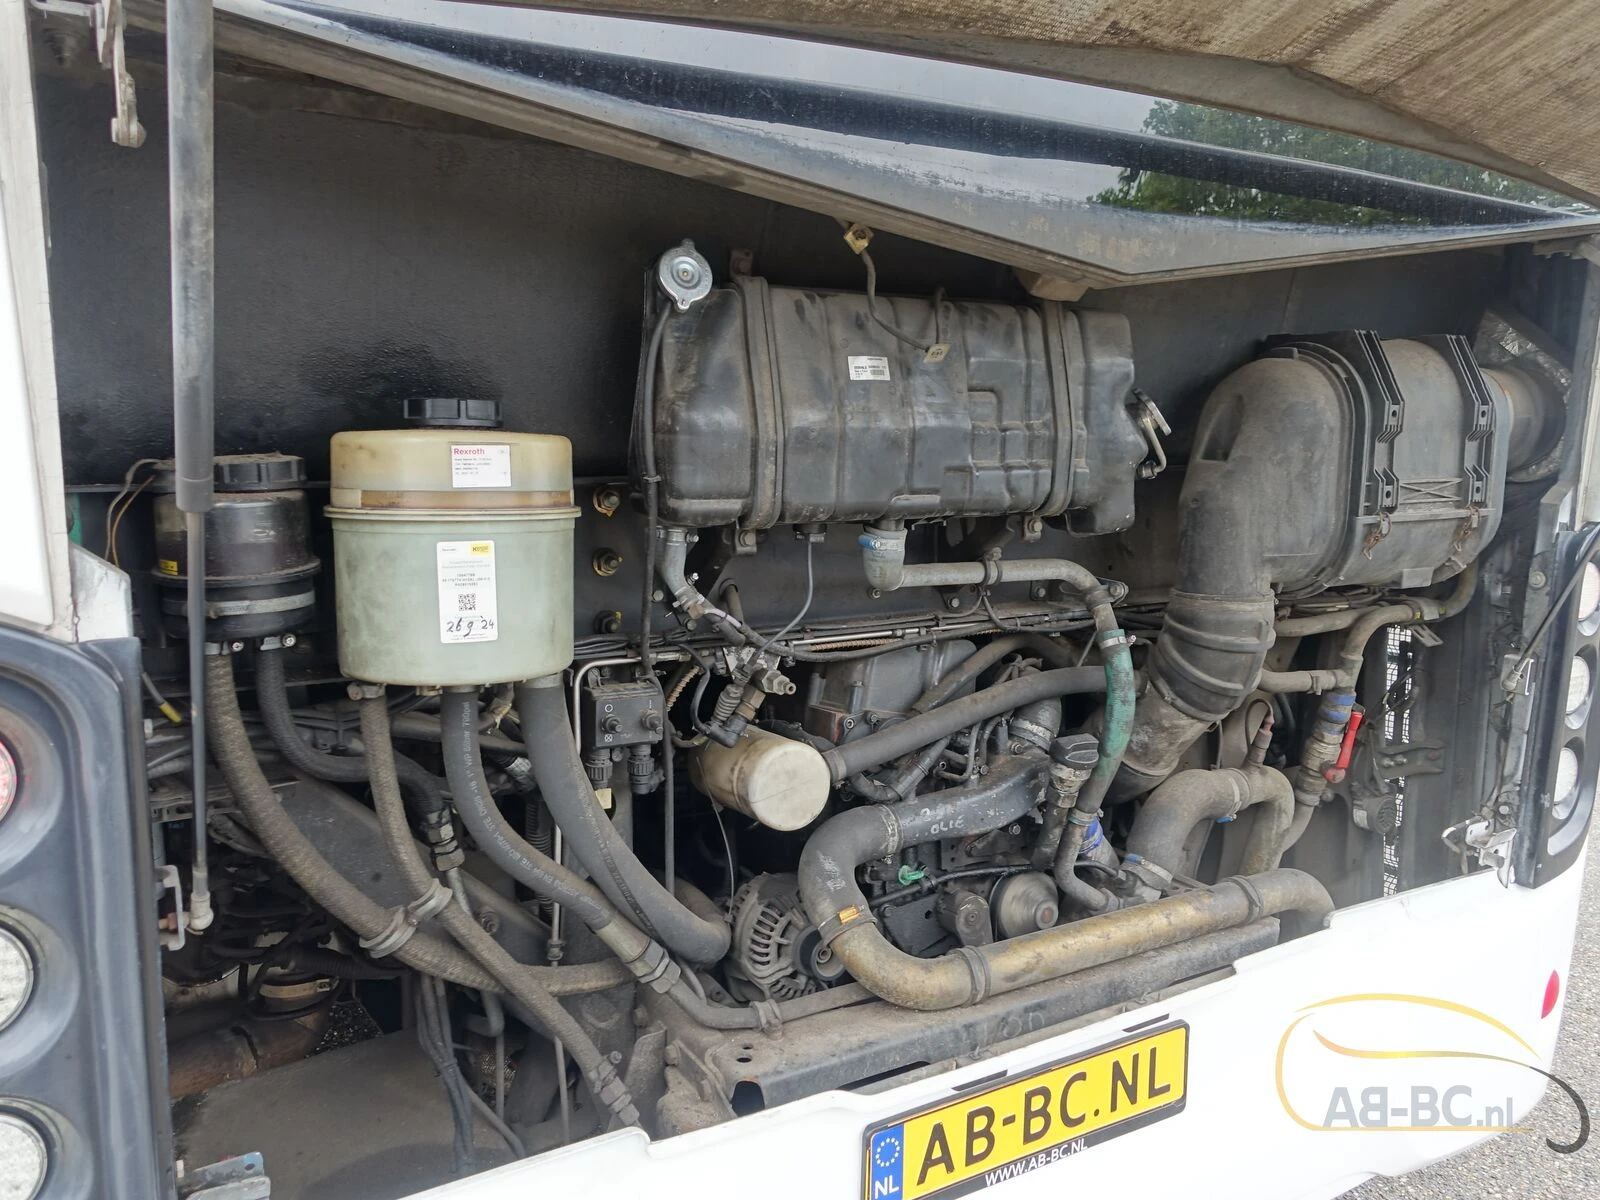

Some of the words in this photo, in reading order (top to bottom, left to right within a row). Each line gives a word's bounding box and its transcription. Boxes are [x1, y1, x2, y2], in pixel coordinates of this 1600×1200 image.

[916, 1047, 1171, 1186] AB-BC.NL
[874, 1175, 900, 1199] NL
[985, 1138, 1088, 1187] WWW.AB-BC.NL
